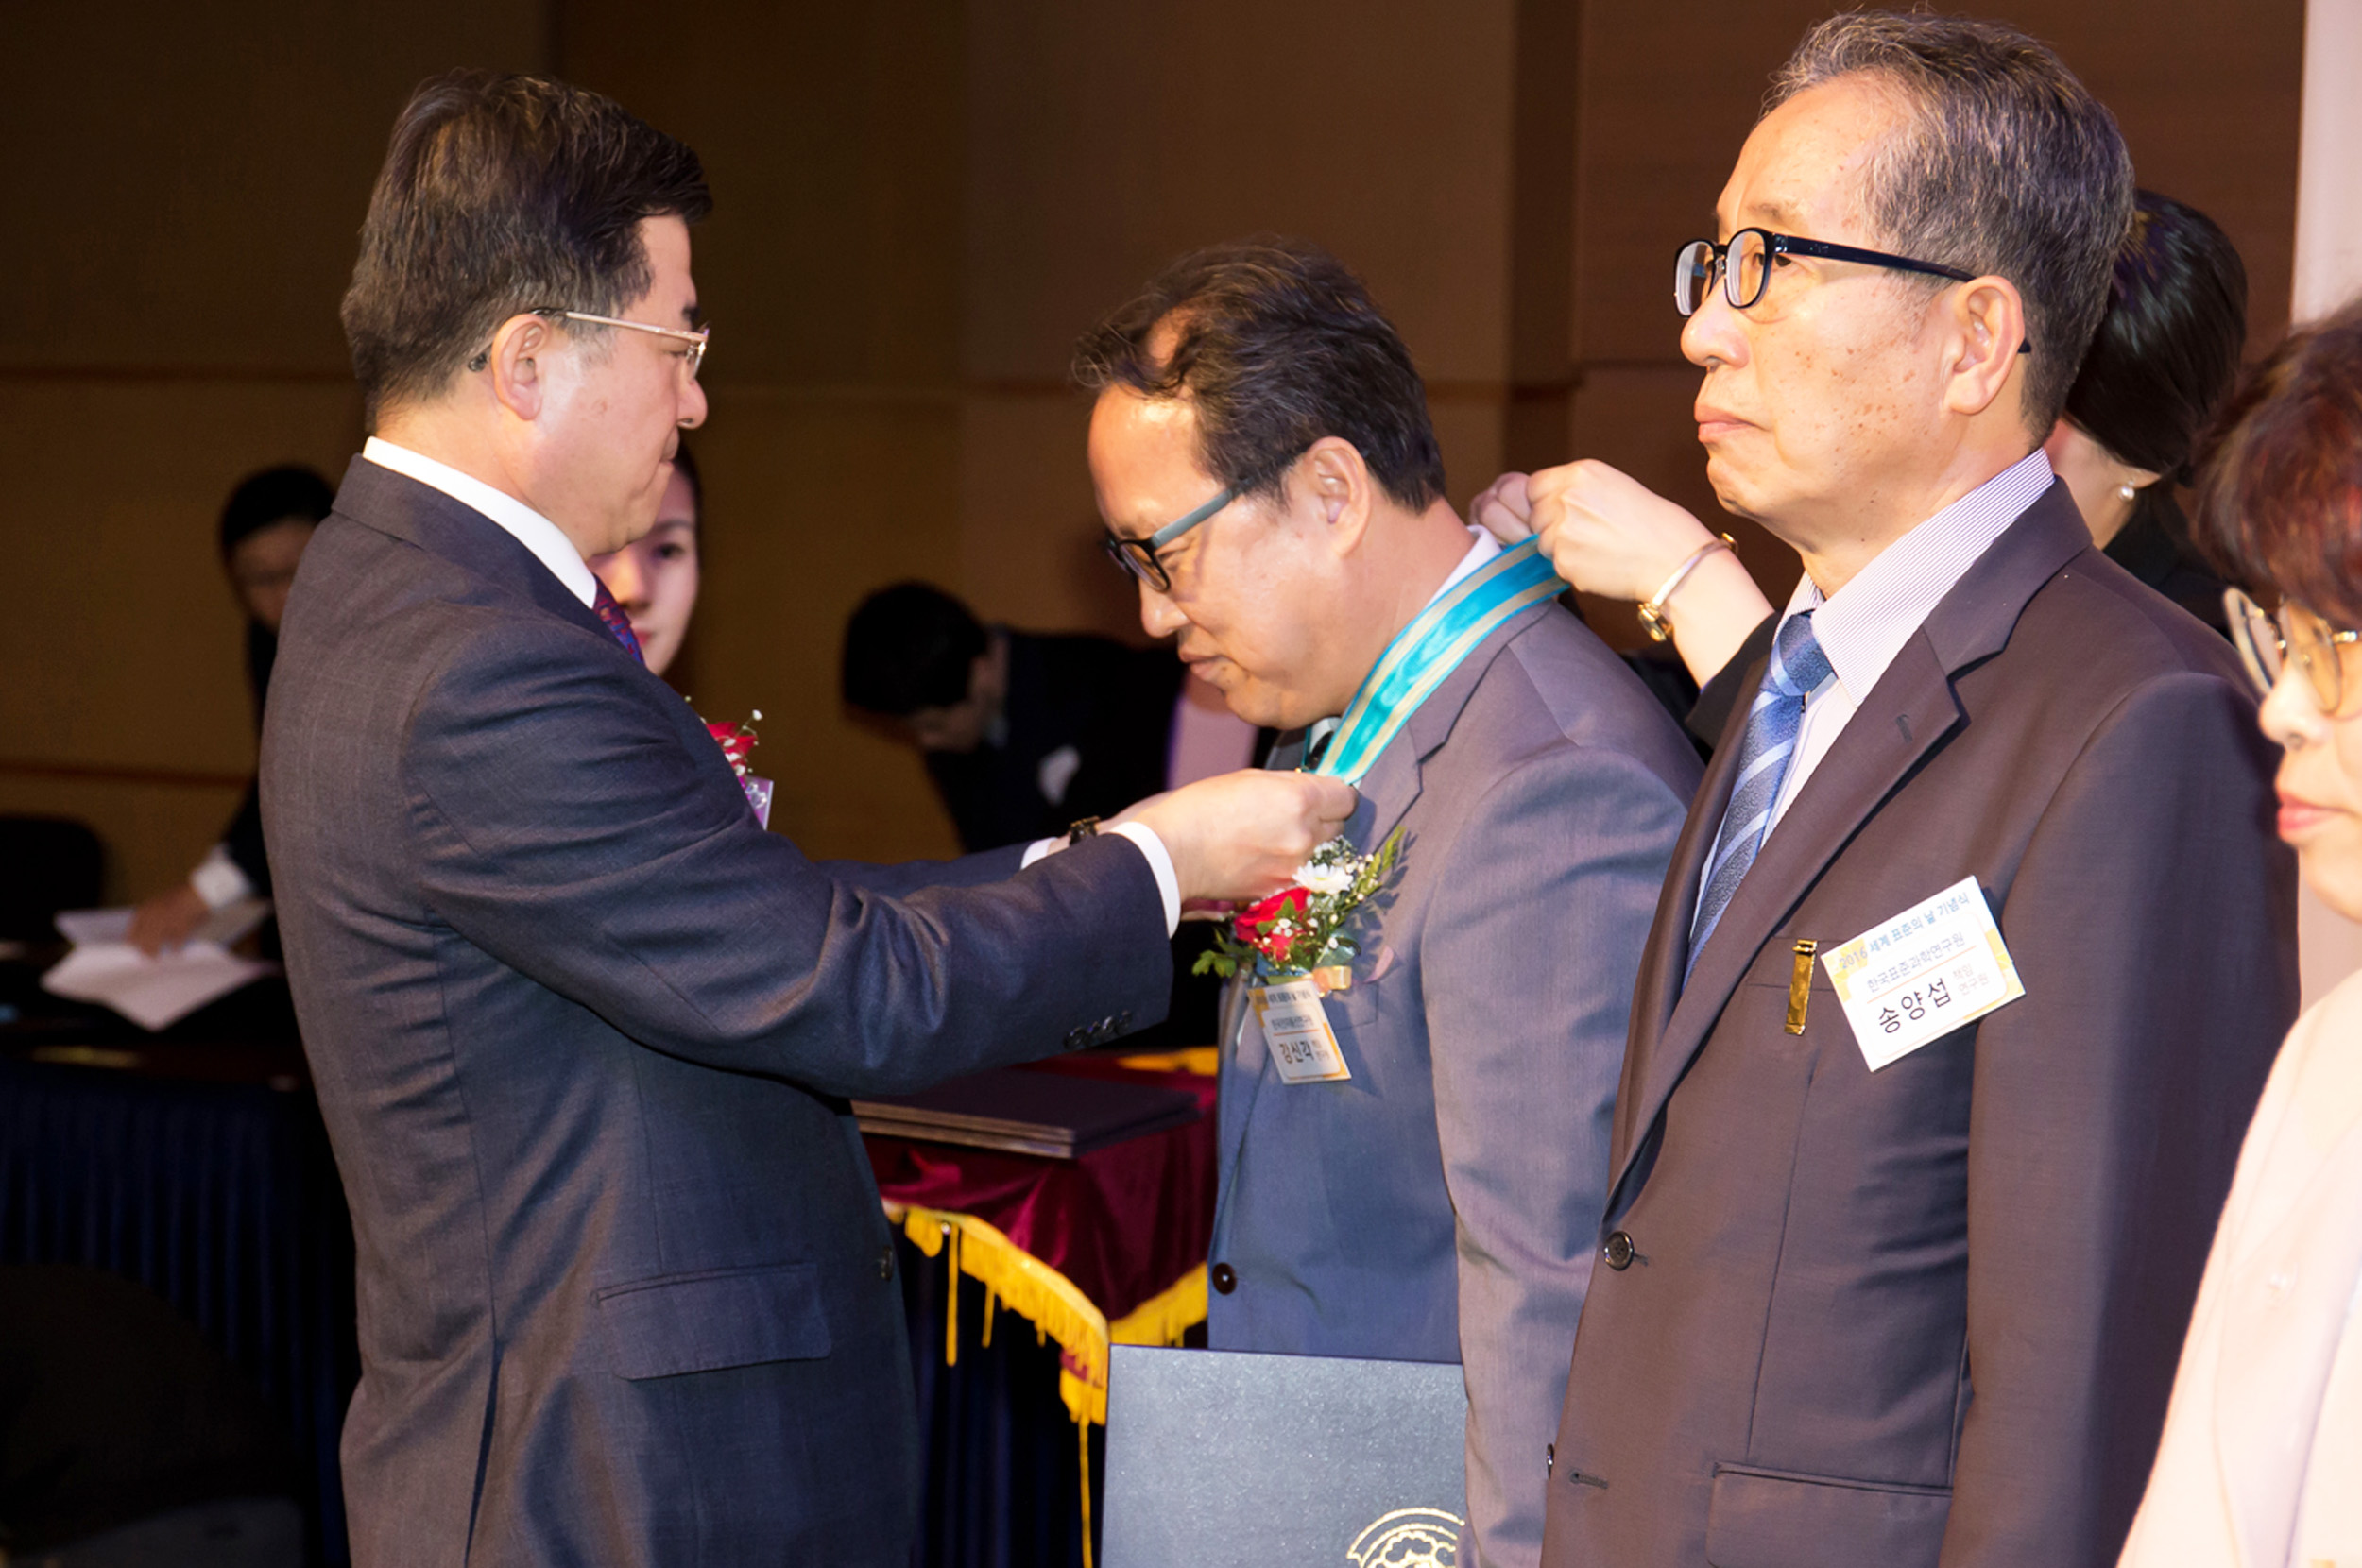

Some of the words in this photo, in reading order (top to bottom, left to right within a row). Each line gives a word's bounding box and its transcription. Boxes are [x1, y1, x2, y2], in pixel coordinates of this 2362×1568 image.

[1839, 946, 1868, 969] 2016
[1869, 934, 1891, 952] 세계
[1891, 917, 1923, 942] 표준의
[1924, 910, 1937, 924] 날
[1938, 893, 1969, 917] 기념식
[1867, 931, 1965, 993] 한국표준과학연구원
[1878, 978, 1951, 1033] 송양섭
